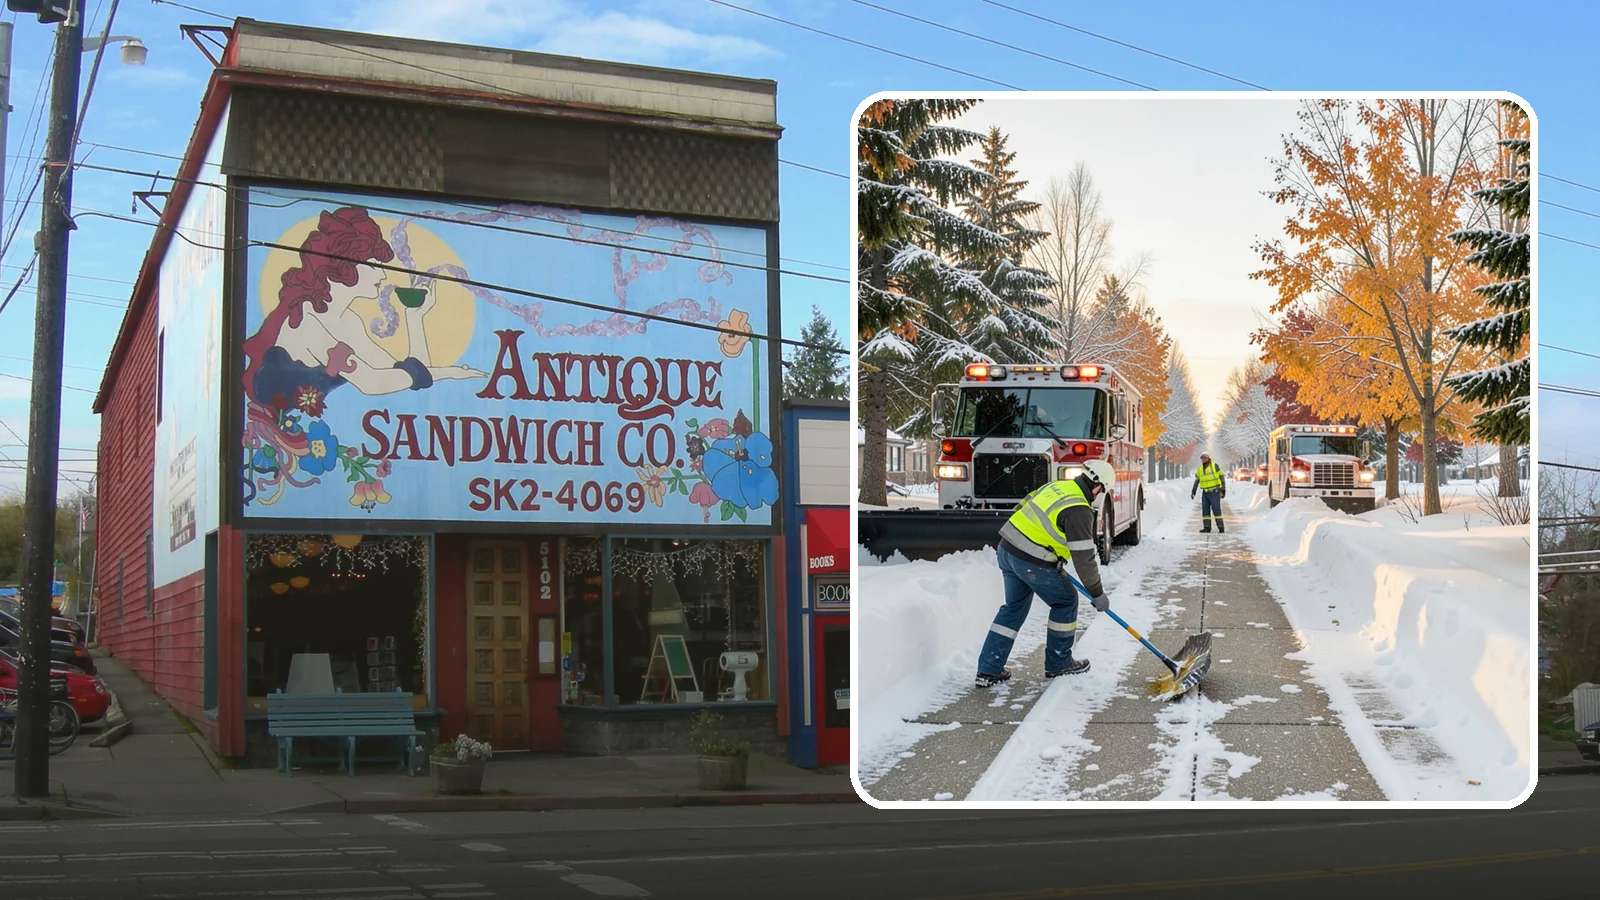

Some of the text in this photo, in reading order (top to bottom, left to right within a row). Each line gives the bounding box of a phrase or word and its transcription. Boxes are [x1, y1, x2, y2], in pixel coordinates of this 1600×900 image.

[475, 328, 723, 421] ANTIQUE
[361, 408, 685, 468] SANDWICH CO.
[469, 477, 646, 513] SK2-4069
[540, 541, 551, 599] 5102
[809, 555, 835, 569] BOOKS
